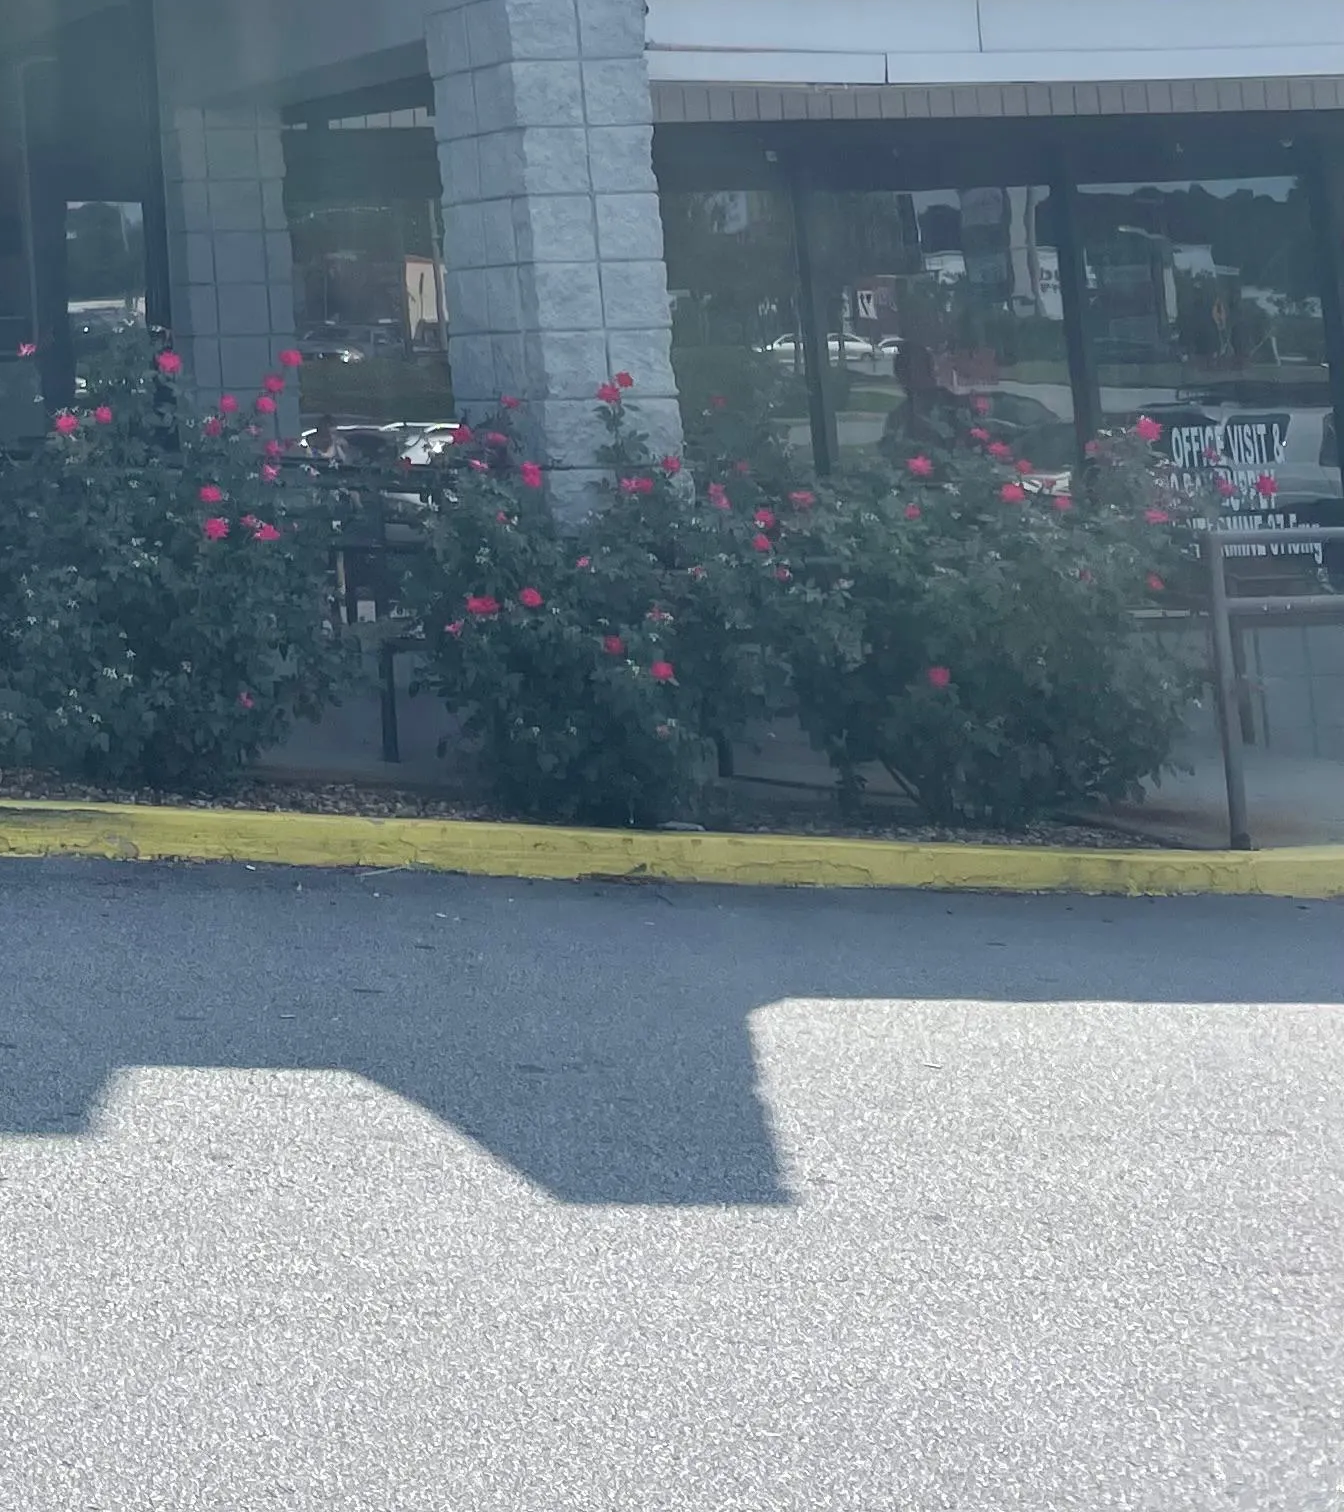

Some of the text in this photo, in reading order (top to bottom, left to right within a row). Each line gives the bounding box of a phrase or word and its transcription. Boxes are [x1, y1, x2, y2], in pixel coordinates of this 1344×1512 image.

[1172, 423, 1286, 468] OFFICE VISIT &
